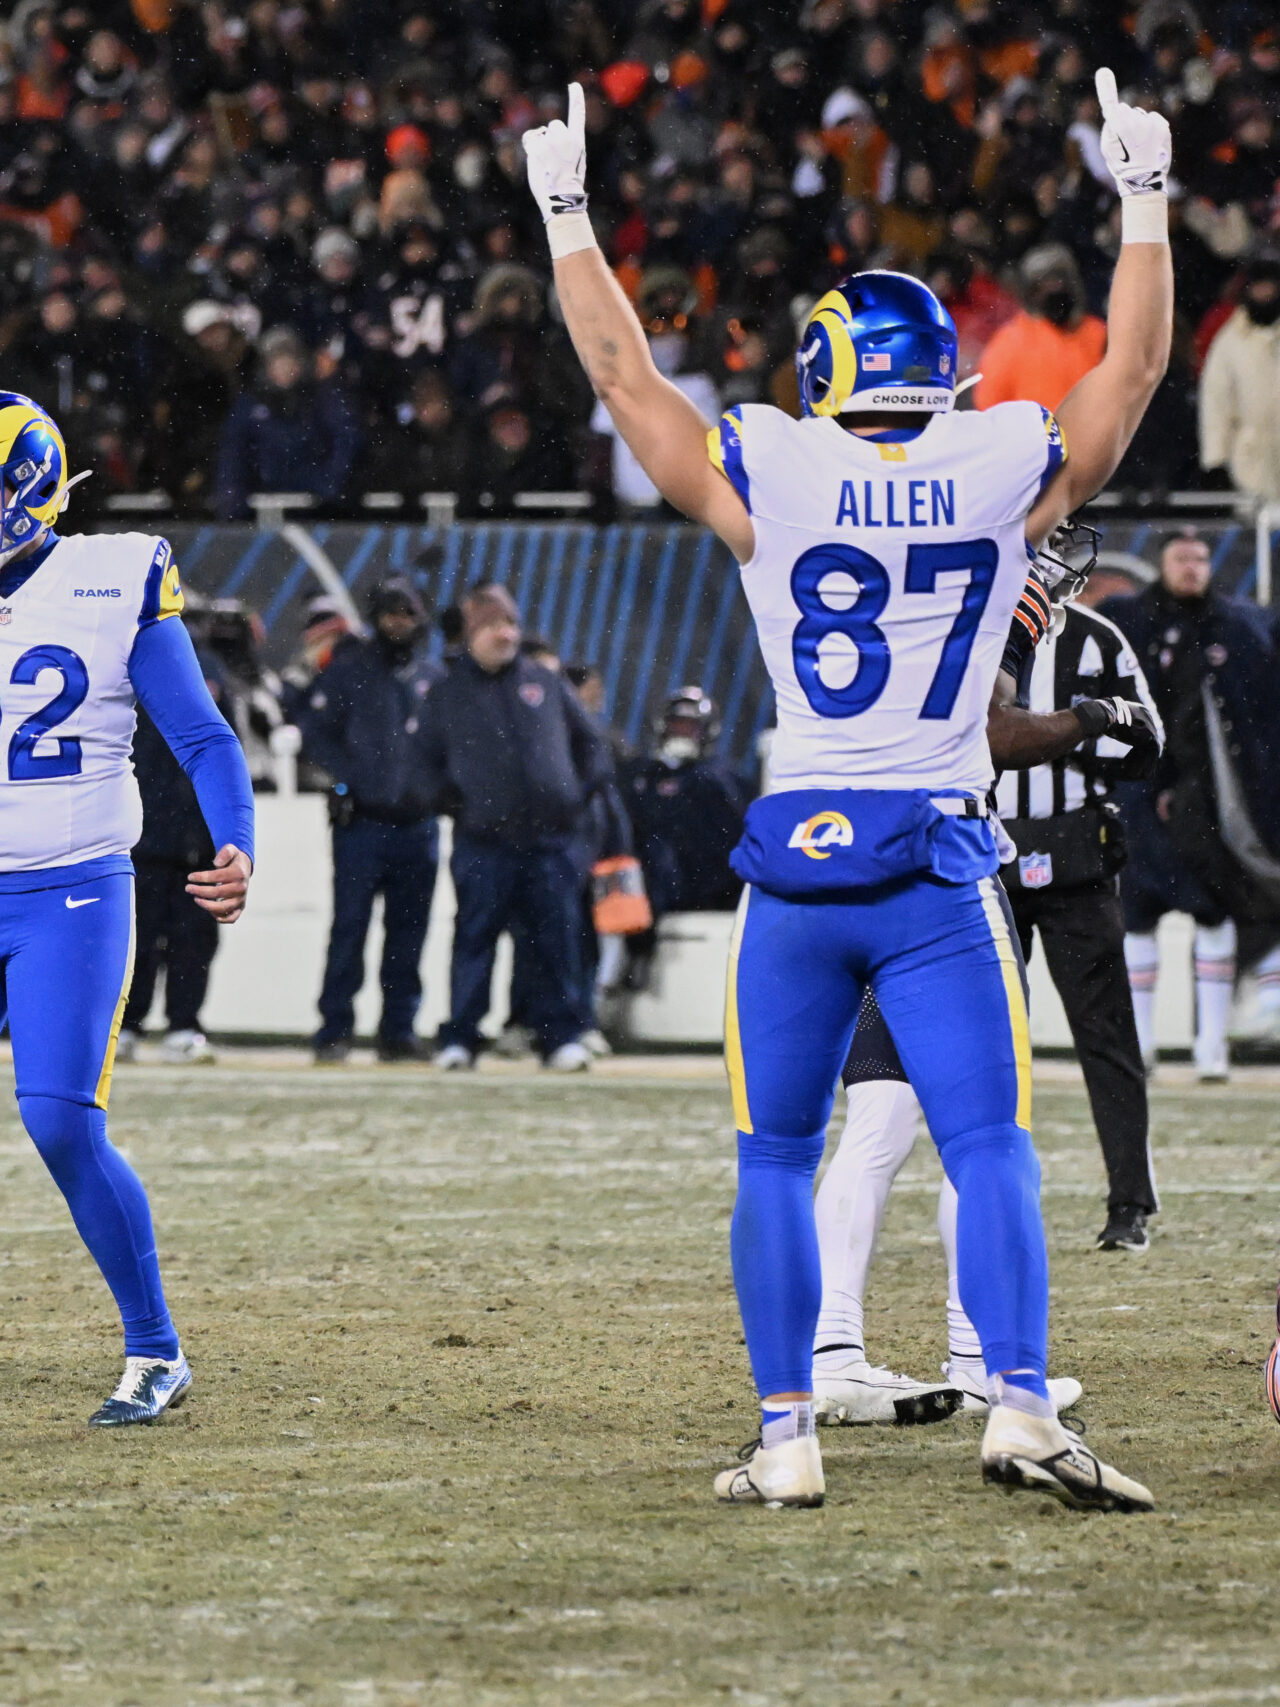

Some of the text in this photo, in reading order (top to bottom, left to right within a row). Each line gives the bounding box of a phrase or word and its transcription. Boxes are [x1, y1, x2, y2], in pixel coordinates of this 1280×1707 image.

[872, 395, 949, 404] CHOOSE LOVE
[835, 479, 955, 527] ALLEN
[74, 589, 121, 597] RAMS
[790, 538, 999, 720] 87
[787, 811, 854, 859] LA
